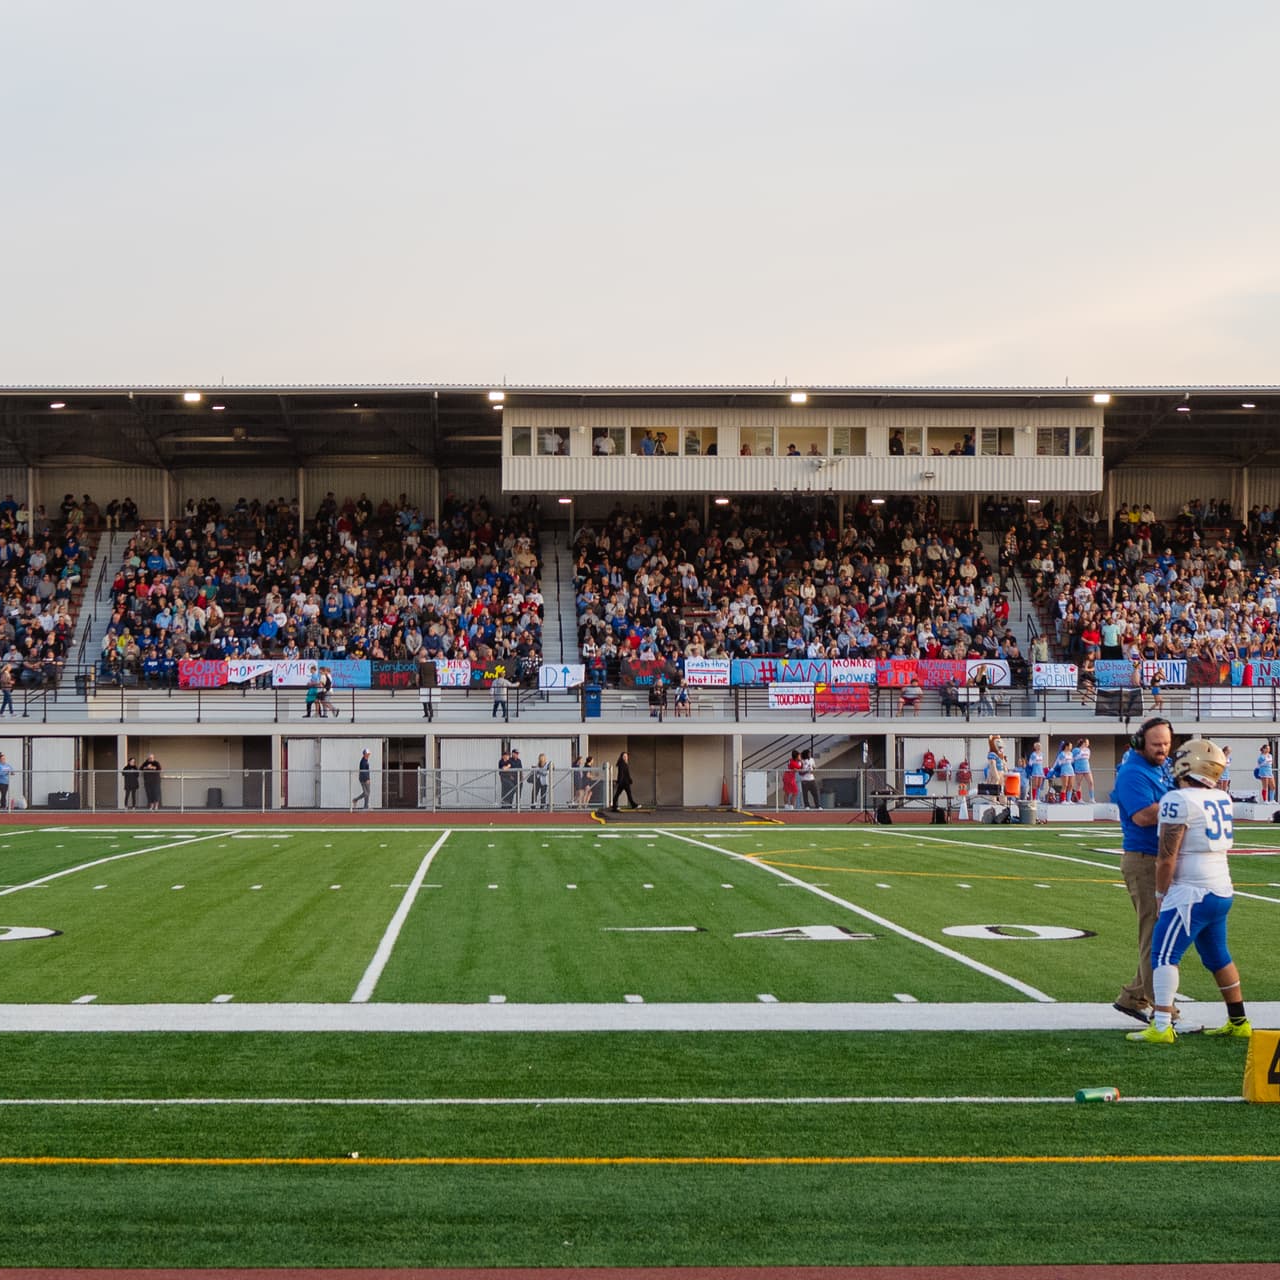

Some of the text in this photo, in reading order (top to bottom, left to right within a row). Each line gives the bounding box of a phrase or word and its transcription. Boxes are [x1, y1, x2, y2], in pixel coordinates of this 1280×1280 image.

[1045, 664, 1070, 673] HEY
[687, 674, 707, 684] that
[838, 673, 877, 684] POWER
[1160, 802, 1180, 819] 35
[1203, 799, 1233, 841] 35
